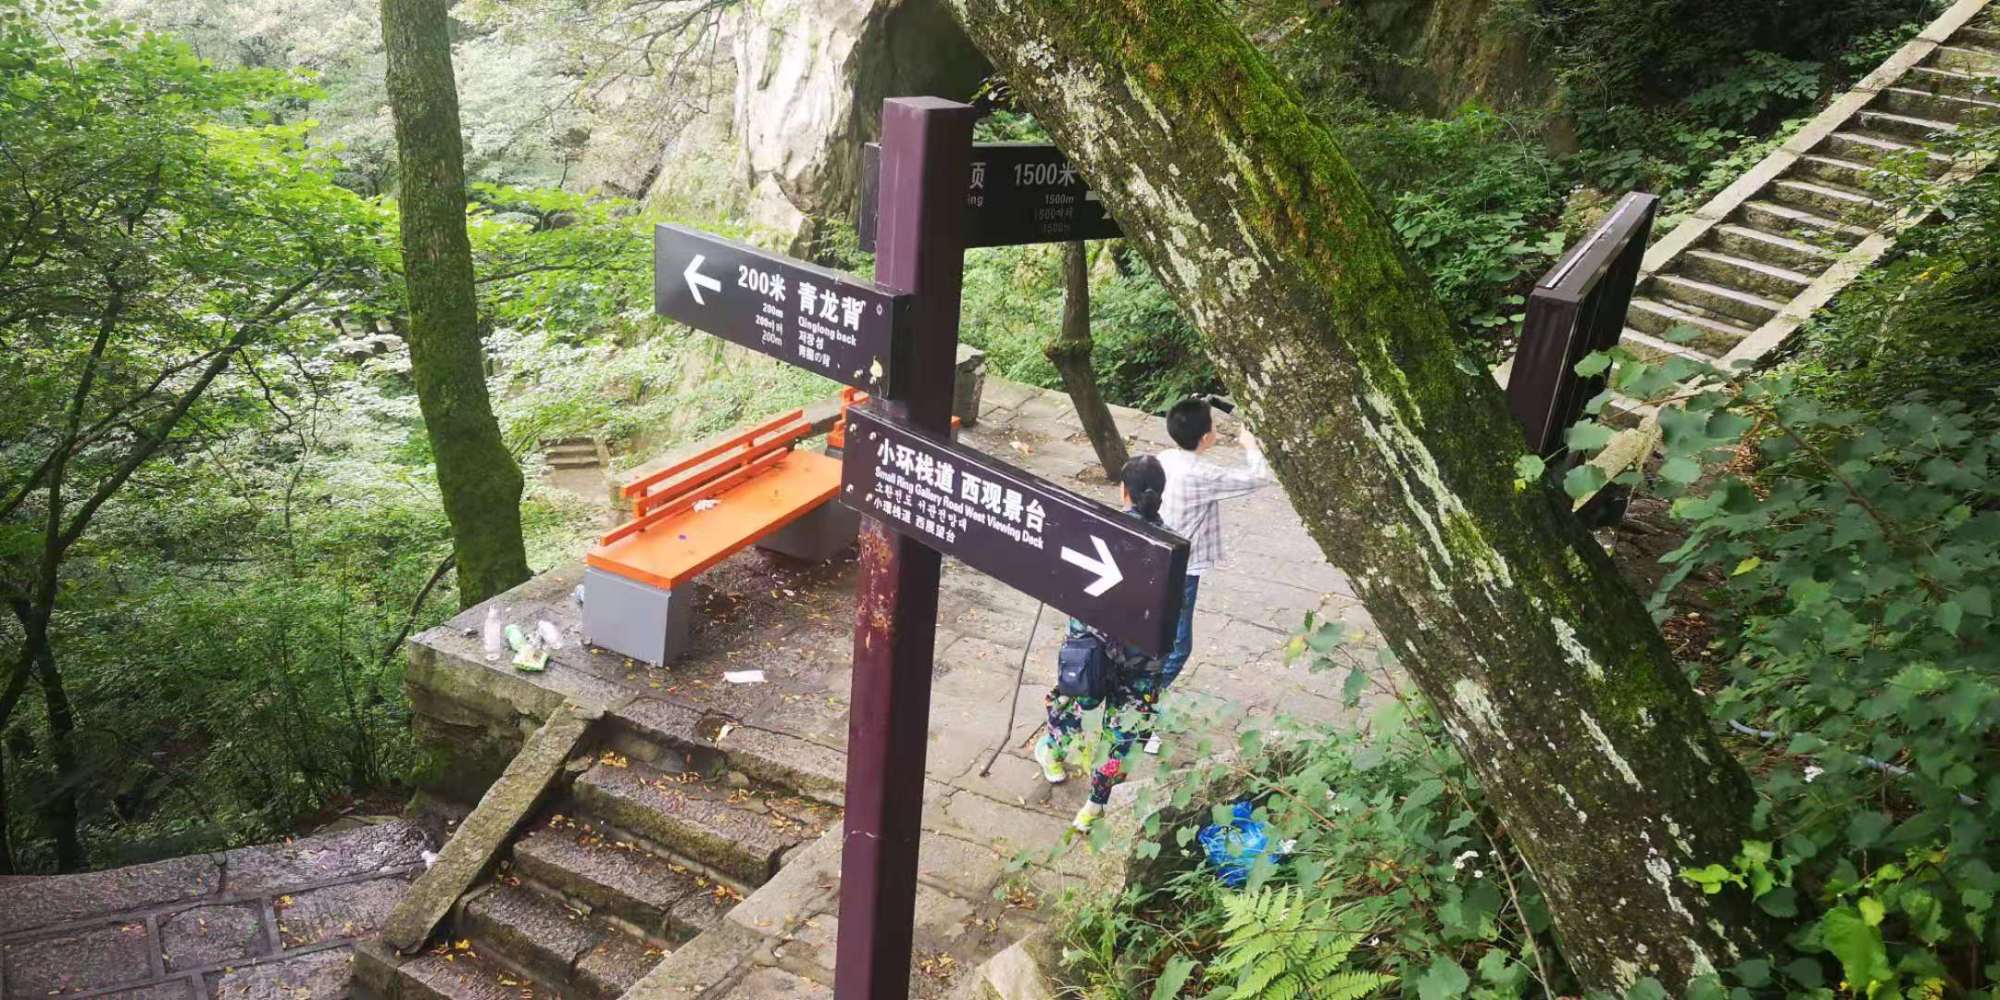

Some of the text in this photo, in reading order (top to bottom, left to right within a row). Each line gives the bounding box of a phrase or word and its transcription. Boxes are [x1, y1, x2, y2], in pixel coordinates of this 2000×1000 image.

[1014, 162, 1077, 187] 1500米
[1045, 193, 1074, 205] 1500m
[738, 264, 866, 331] 200米 青龙背
[762, 302, 857, 346] 200m Qinglong back
[762, 330, 783, 346] 200m
[877, 438, 1046, 533] 小环栈道 西观景台
[875, 466, 1044, 550] Small Ring Gallery Road West Viewing Deck
